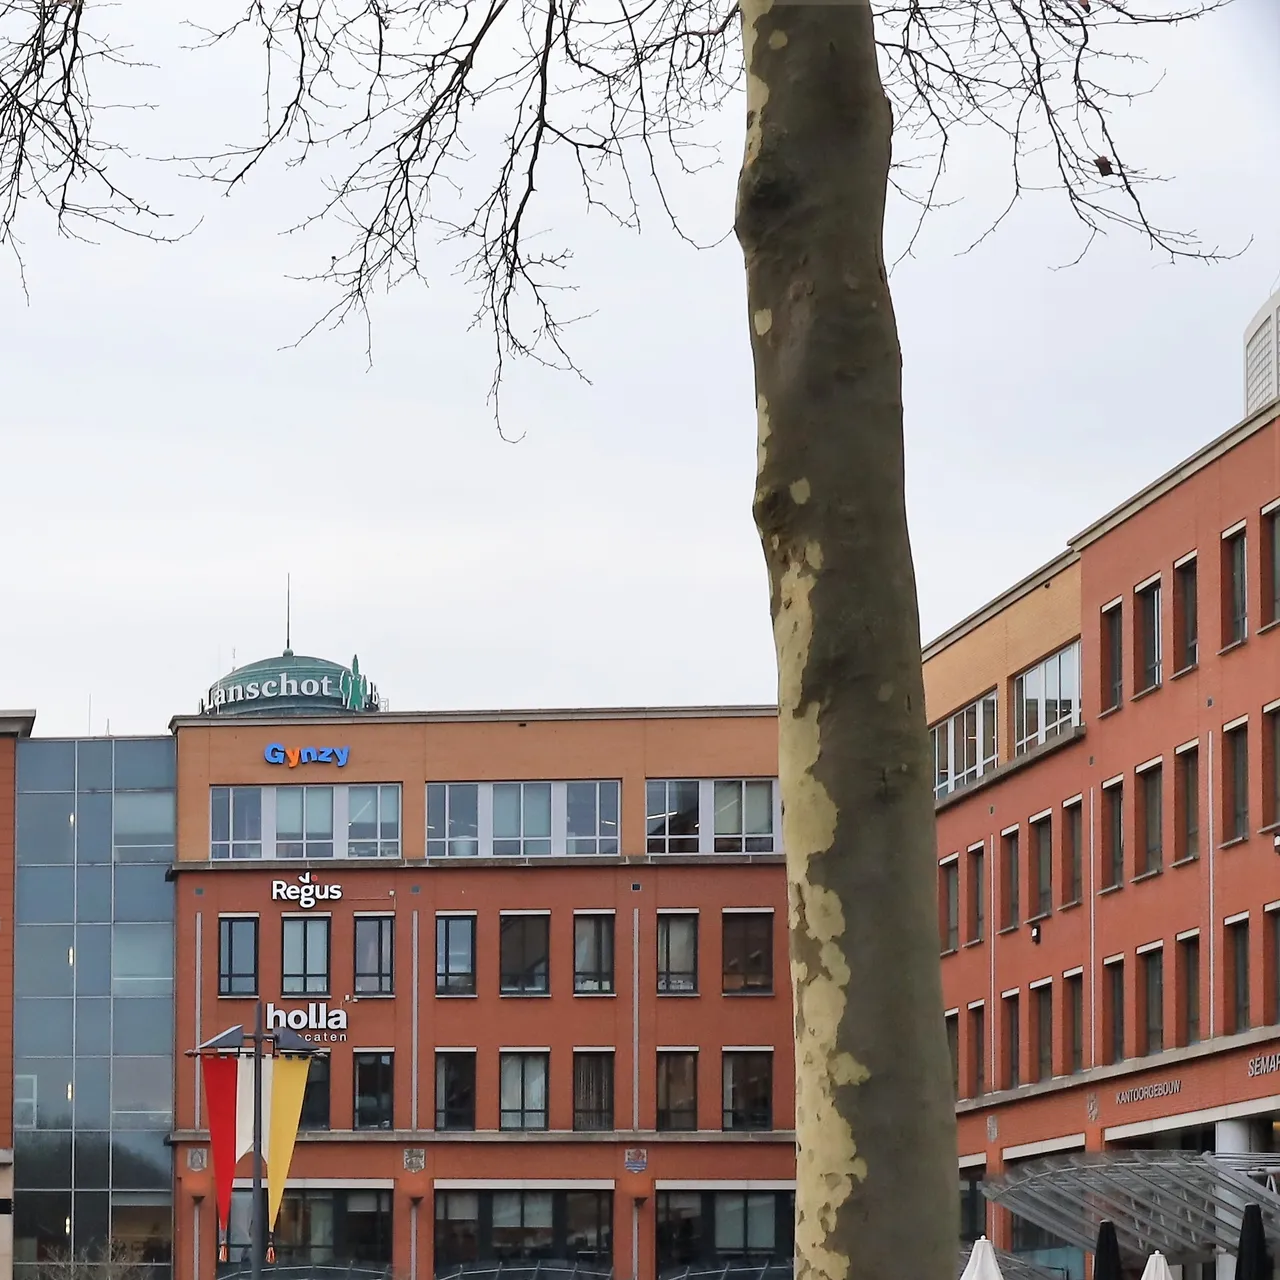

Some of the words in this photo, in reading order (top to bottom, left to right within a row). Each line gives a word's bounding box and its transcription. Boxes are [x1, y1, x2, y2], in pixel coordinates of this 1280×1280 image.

[264, 743, 350, 768] Gynzy
[271, 880, 343, 908] Regus
[266, 1002, 347, 1030] holla
[1116, 1079, 1181, 1105] KANTOORGEBOUW
